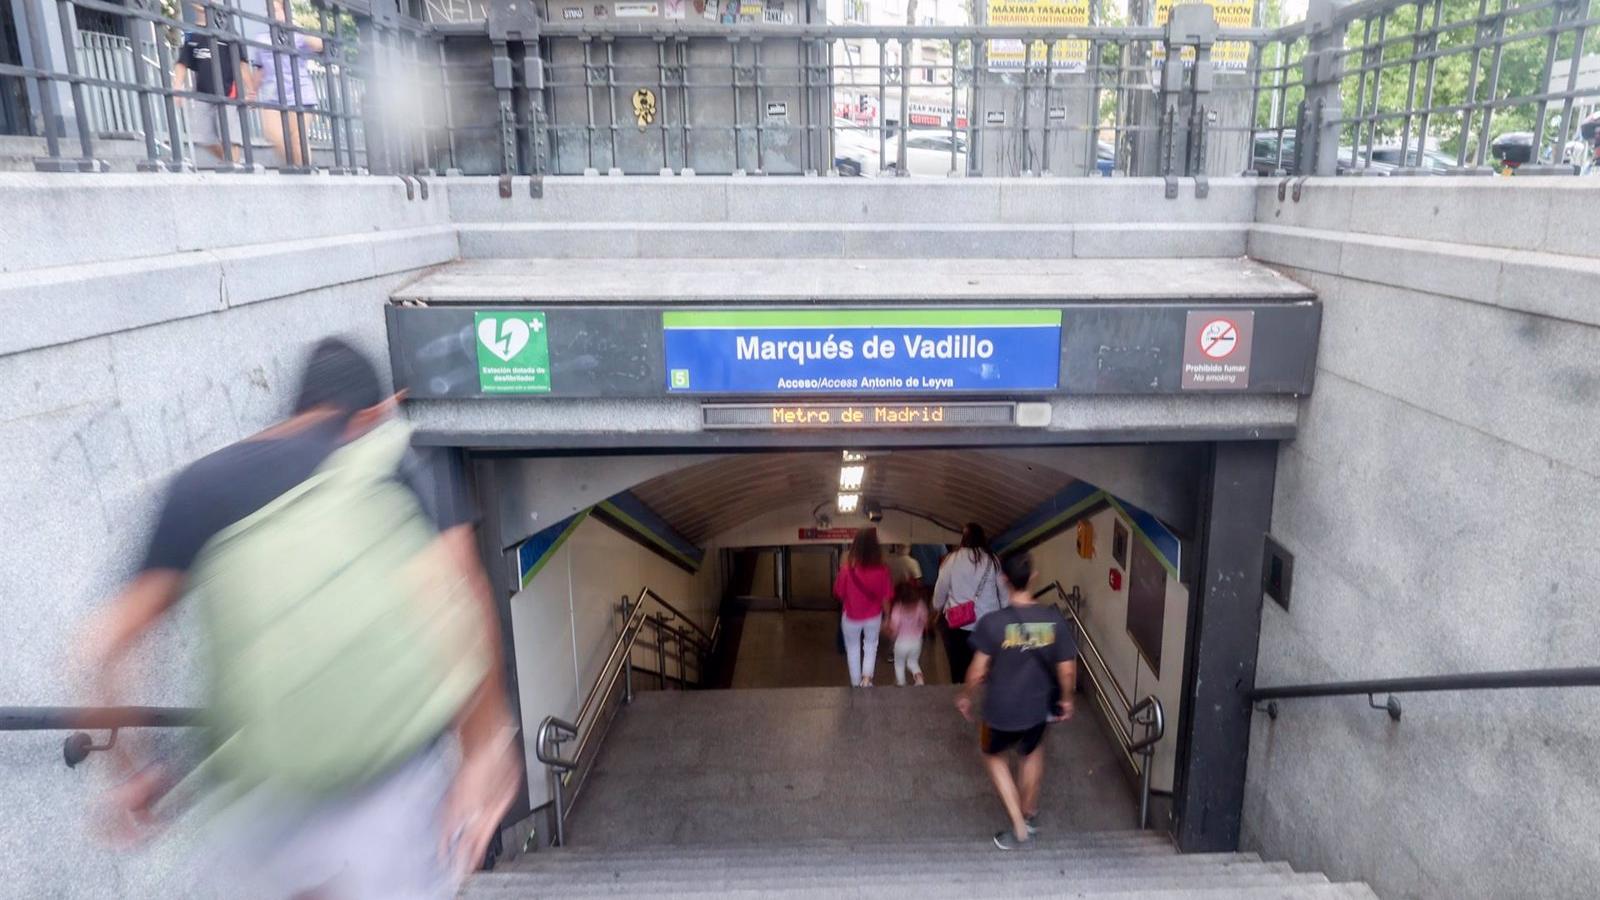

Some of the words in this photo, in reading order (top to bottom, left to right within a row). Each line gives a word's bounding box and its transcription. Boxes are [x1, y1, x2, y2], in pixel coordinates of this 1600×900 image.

[992, 5, 1035, 14] MÁXIMA
[1038, 6, 1086, 15] TASACIÓN
[1215, 6, 1251, 15] SACIÓN
[736, 333, 854, 366] Marqués
[862, 335, 896, 359] de
[903, 334, 994, 359] Vadillo
[536, 366, 545, 374] de
[1185, 364, 1223, 373] Prohibido
[1224, 364, 1246, 373] fumar
[675, 371, 684, 386] 5
[777, 377, 858, 390] Acceso/Access
[861, 376, 903, 388] Antonio
[906, 376, 918, 388] de
[922, 376, 954, 390] Leyva
[1193, 374, 1204, 382] No
[1206, 374, 1236, 384] smoking
[772, 407, 829, 423] Metro
[841, 407, 864, 422] de
[875, 406, 944, 423] Madrid
